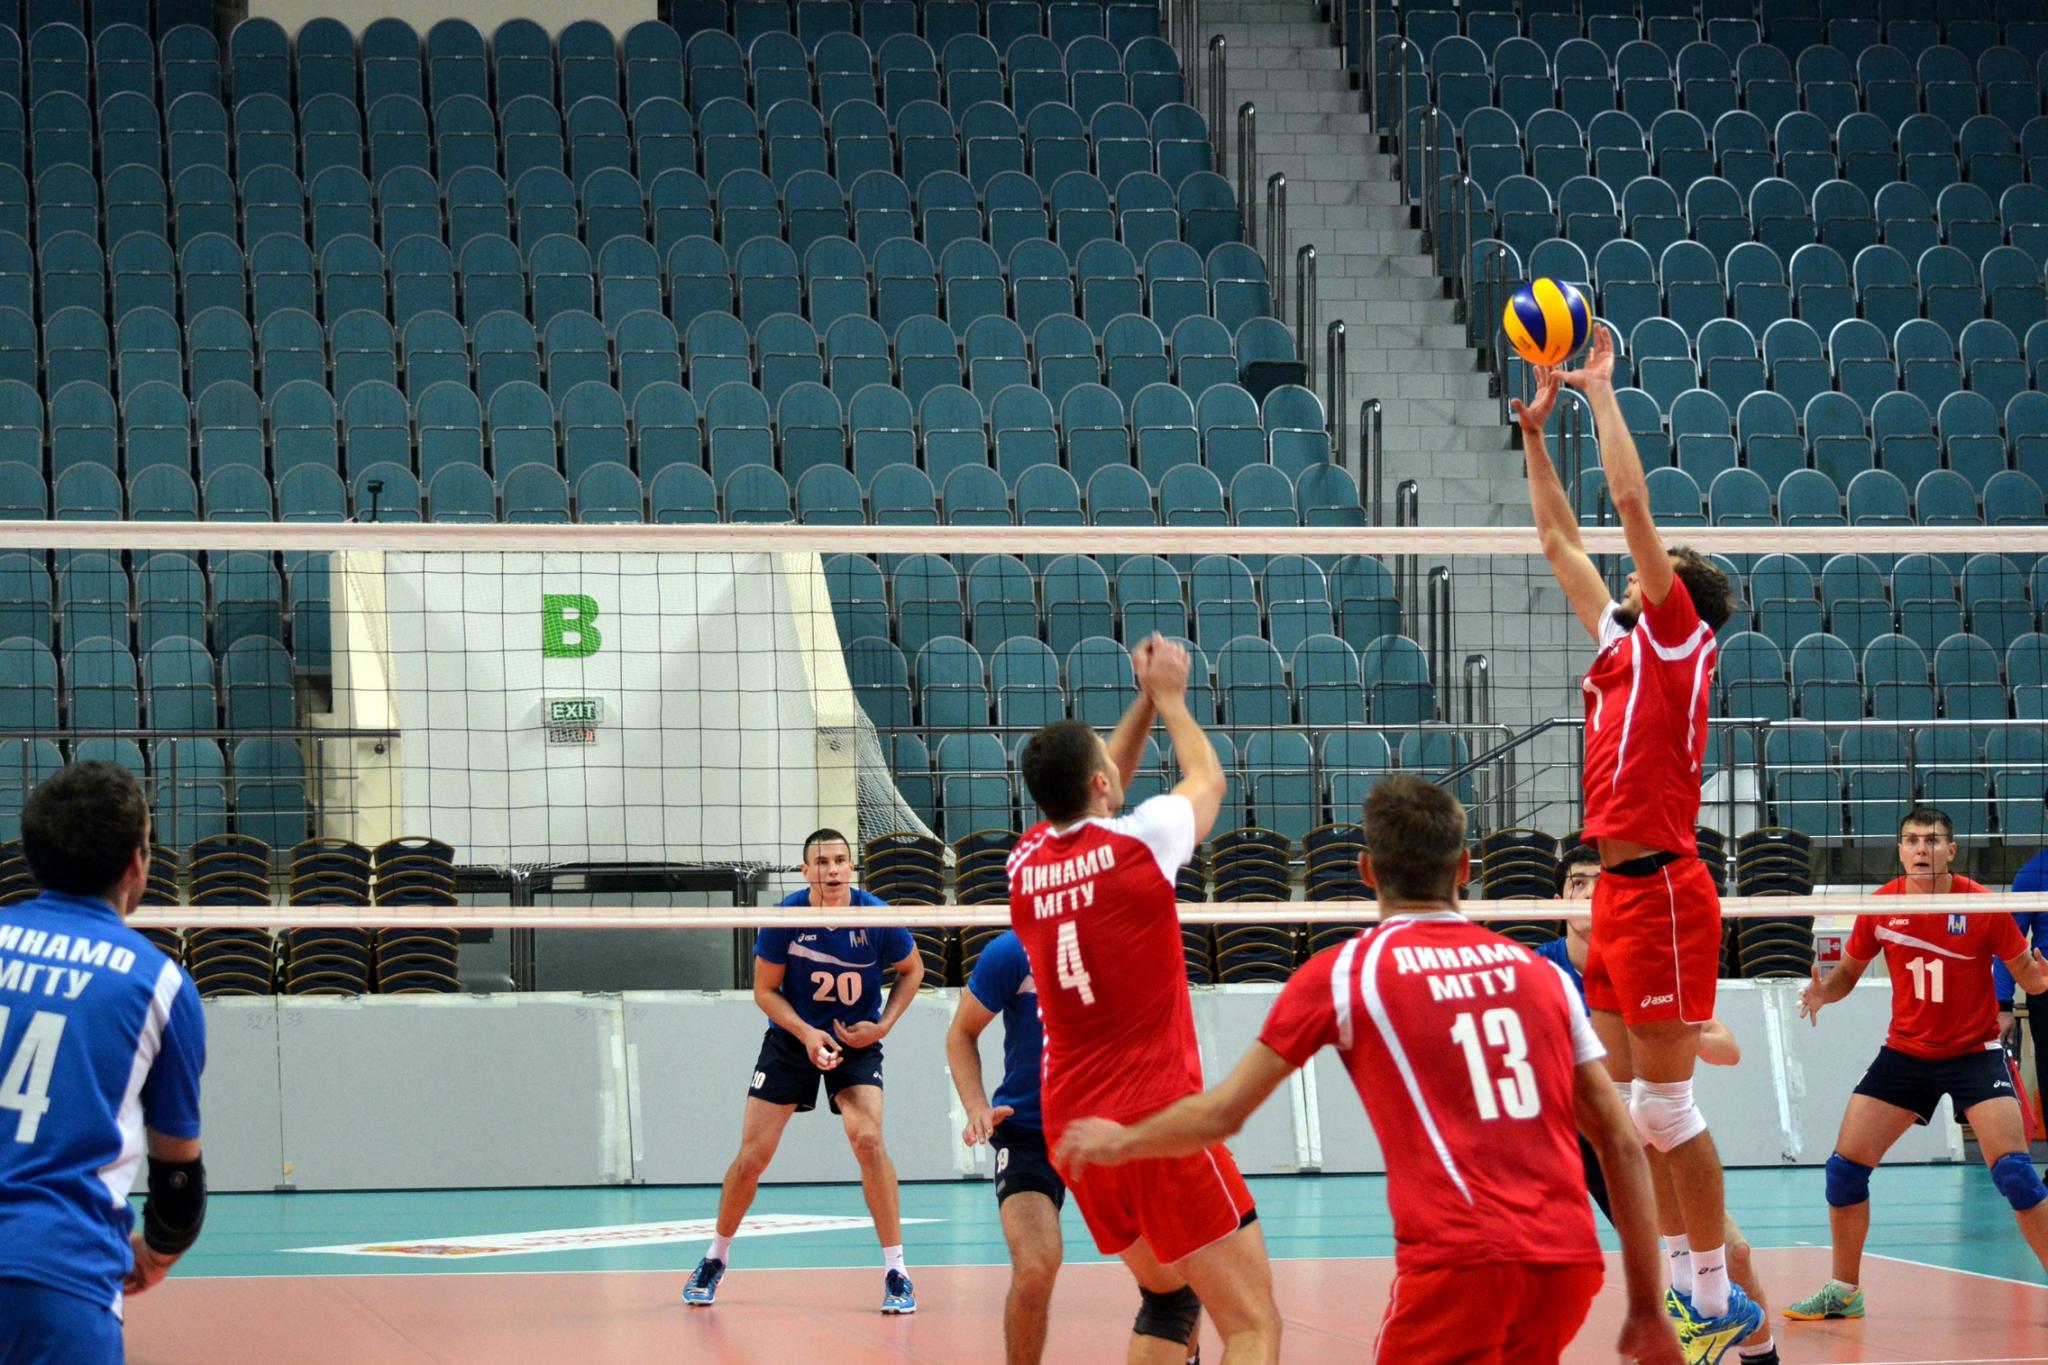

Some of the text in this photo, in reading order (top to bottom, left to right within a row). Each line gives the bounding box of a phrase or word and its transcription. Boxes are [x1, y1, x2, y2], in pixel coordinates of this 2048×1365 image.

[553, 704, 594, 718] EXIT
[1021, 844, 1116, 895] ДИНАМО
[1034, 881, 1095, 920] МГТУ
[1057, 920, 1095, 1006] 4
[1392, 943, 1532, 975] ДИНАМО
[1905, 956, 1944, 1003] 11
[810, 971, 862, 1006] 20
[1427, 966, 1517, 1001] МГТУ
[0, 1004, 67, 1144] 4
[1450, 1007, 1541, 1120] 13
